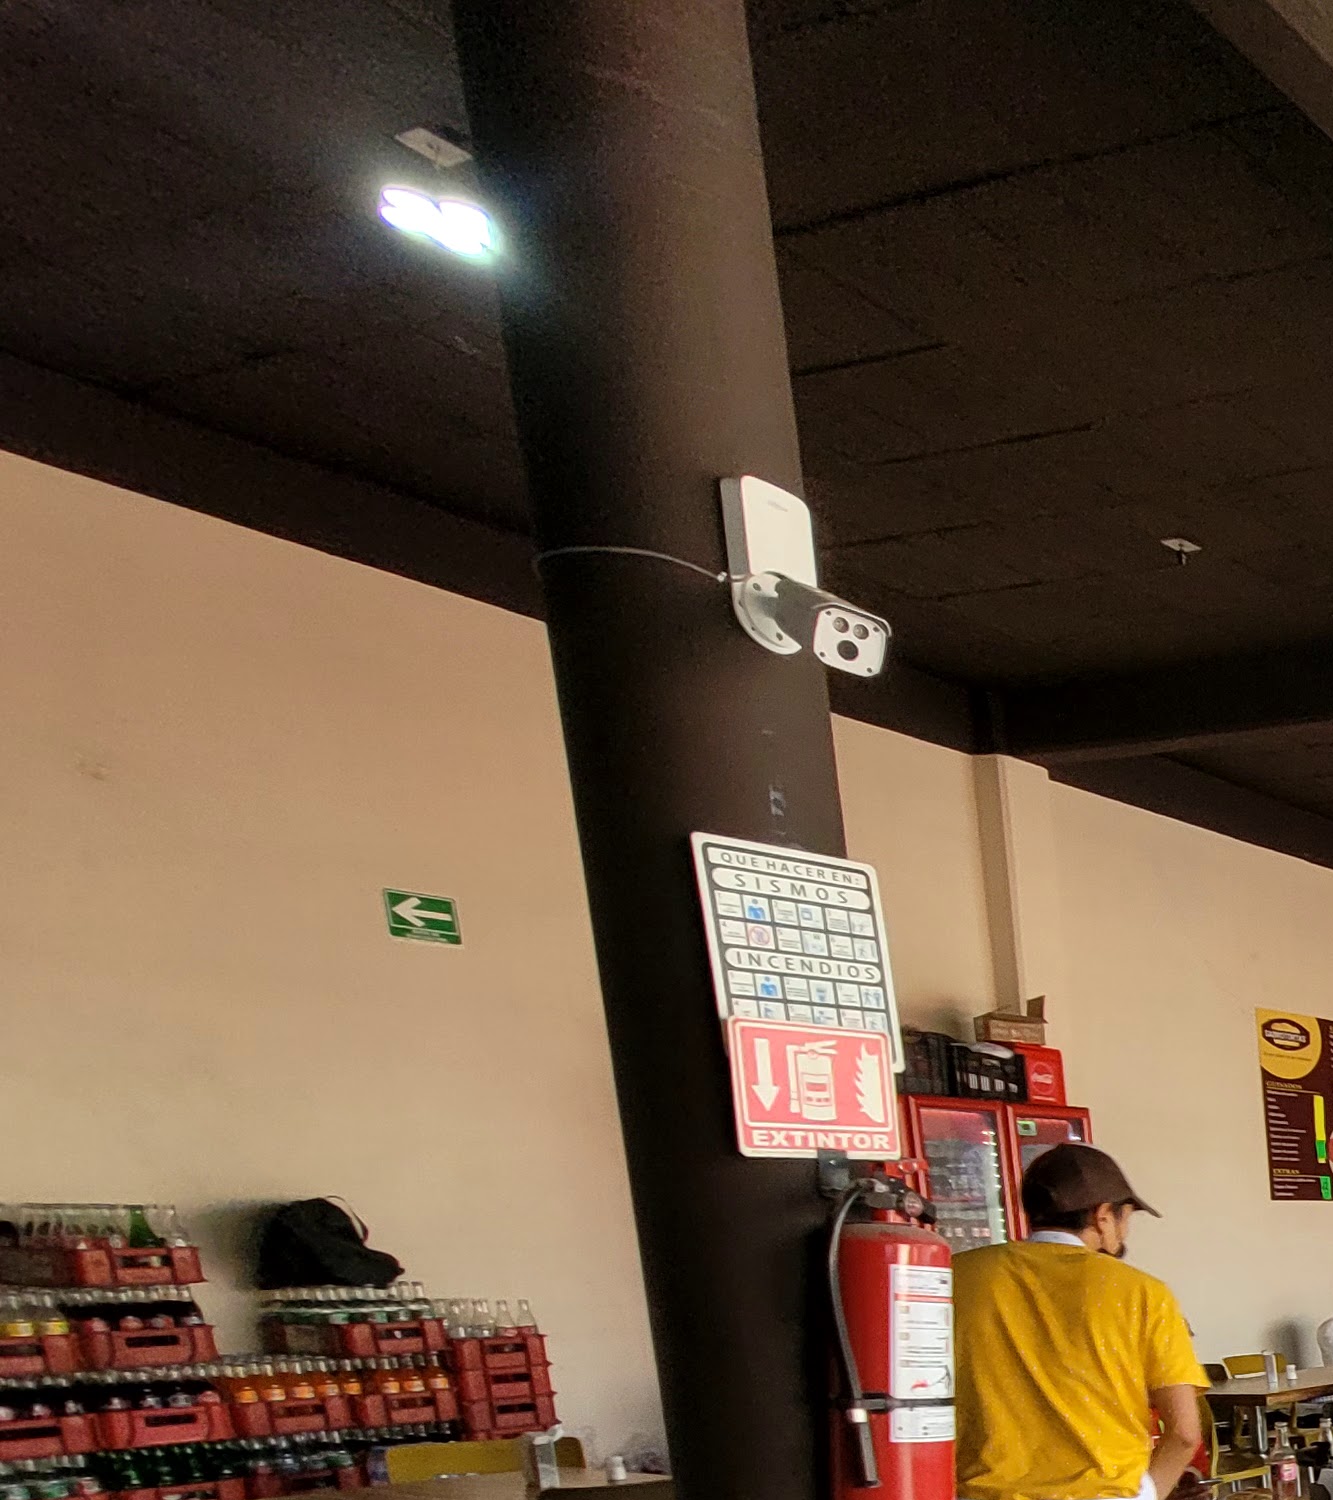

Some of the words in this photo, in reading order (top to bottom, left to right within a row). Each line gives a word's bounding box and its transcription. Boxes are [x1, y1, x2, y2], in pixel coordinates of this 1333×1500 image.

[720, 852, 759, 867] QUE
[766, 860, 826, 879] HACER
[734, 873, 849, 904] SISMOS
[736, 951, 876, 980] INCENDIOS
[752, 1129, 890, 1150] EXTINTOR
